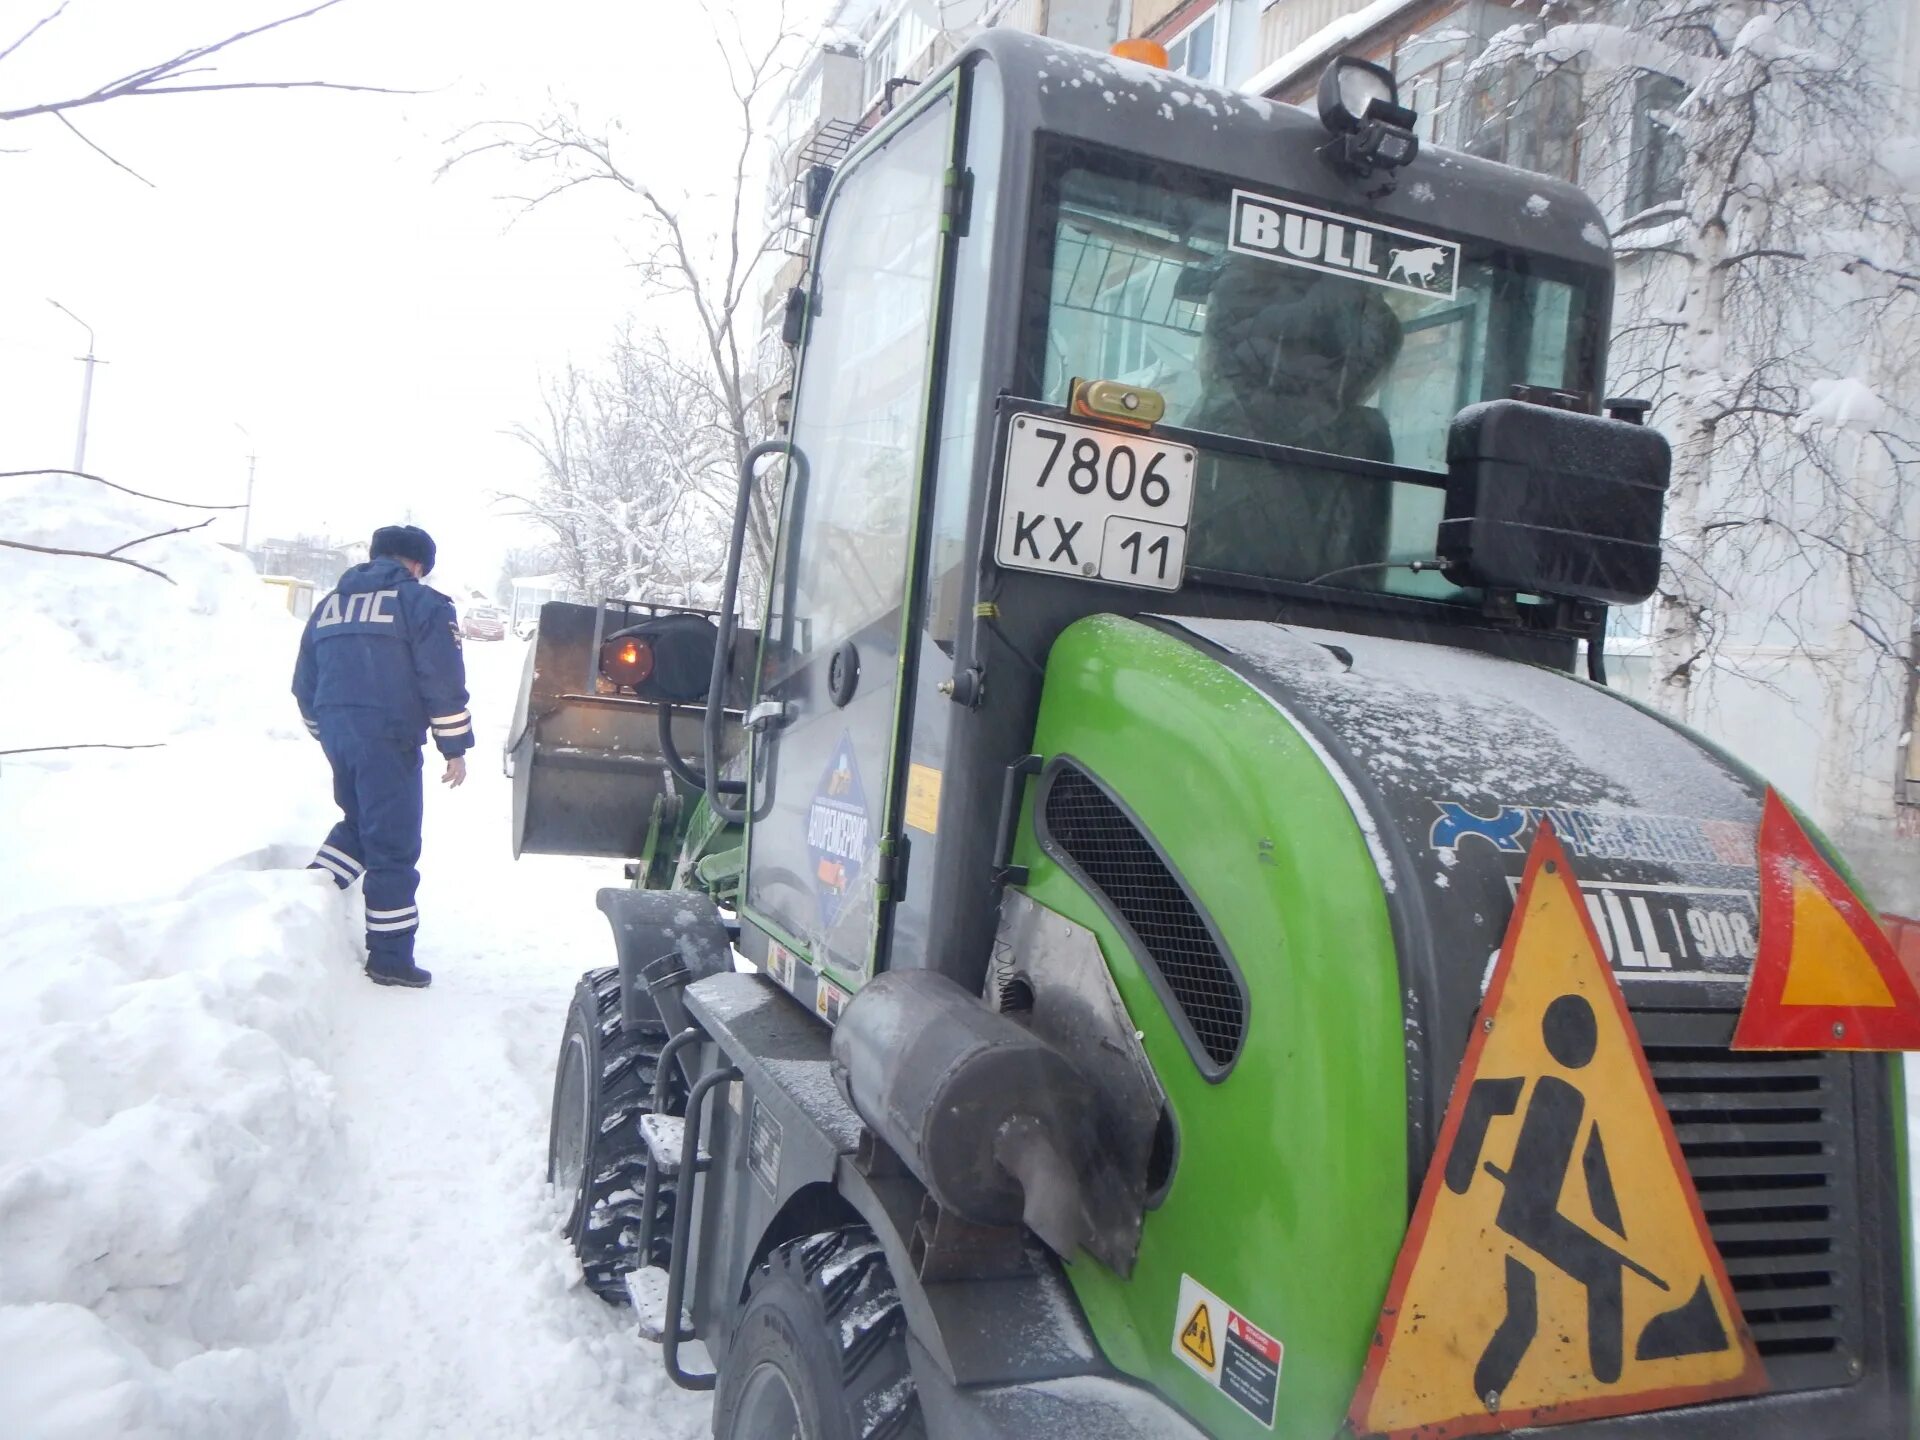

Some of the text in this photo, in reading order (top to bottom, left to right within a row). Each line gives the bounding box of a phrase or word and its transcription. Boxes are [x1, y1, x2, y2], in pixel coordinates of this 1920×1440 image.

[1240, 203, 1379, 274] BULL
[1034, 427, 1170, 508] 7806
[1119, 531, 1169, 580] 11
[316, 590, 398, 629] ДПС
